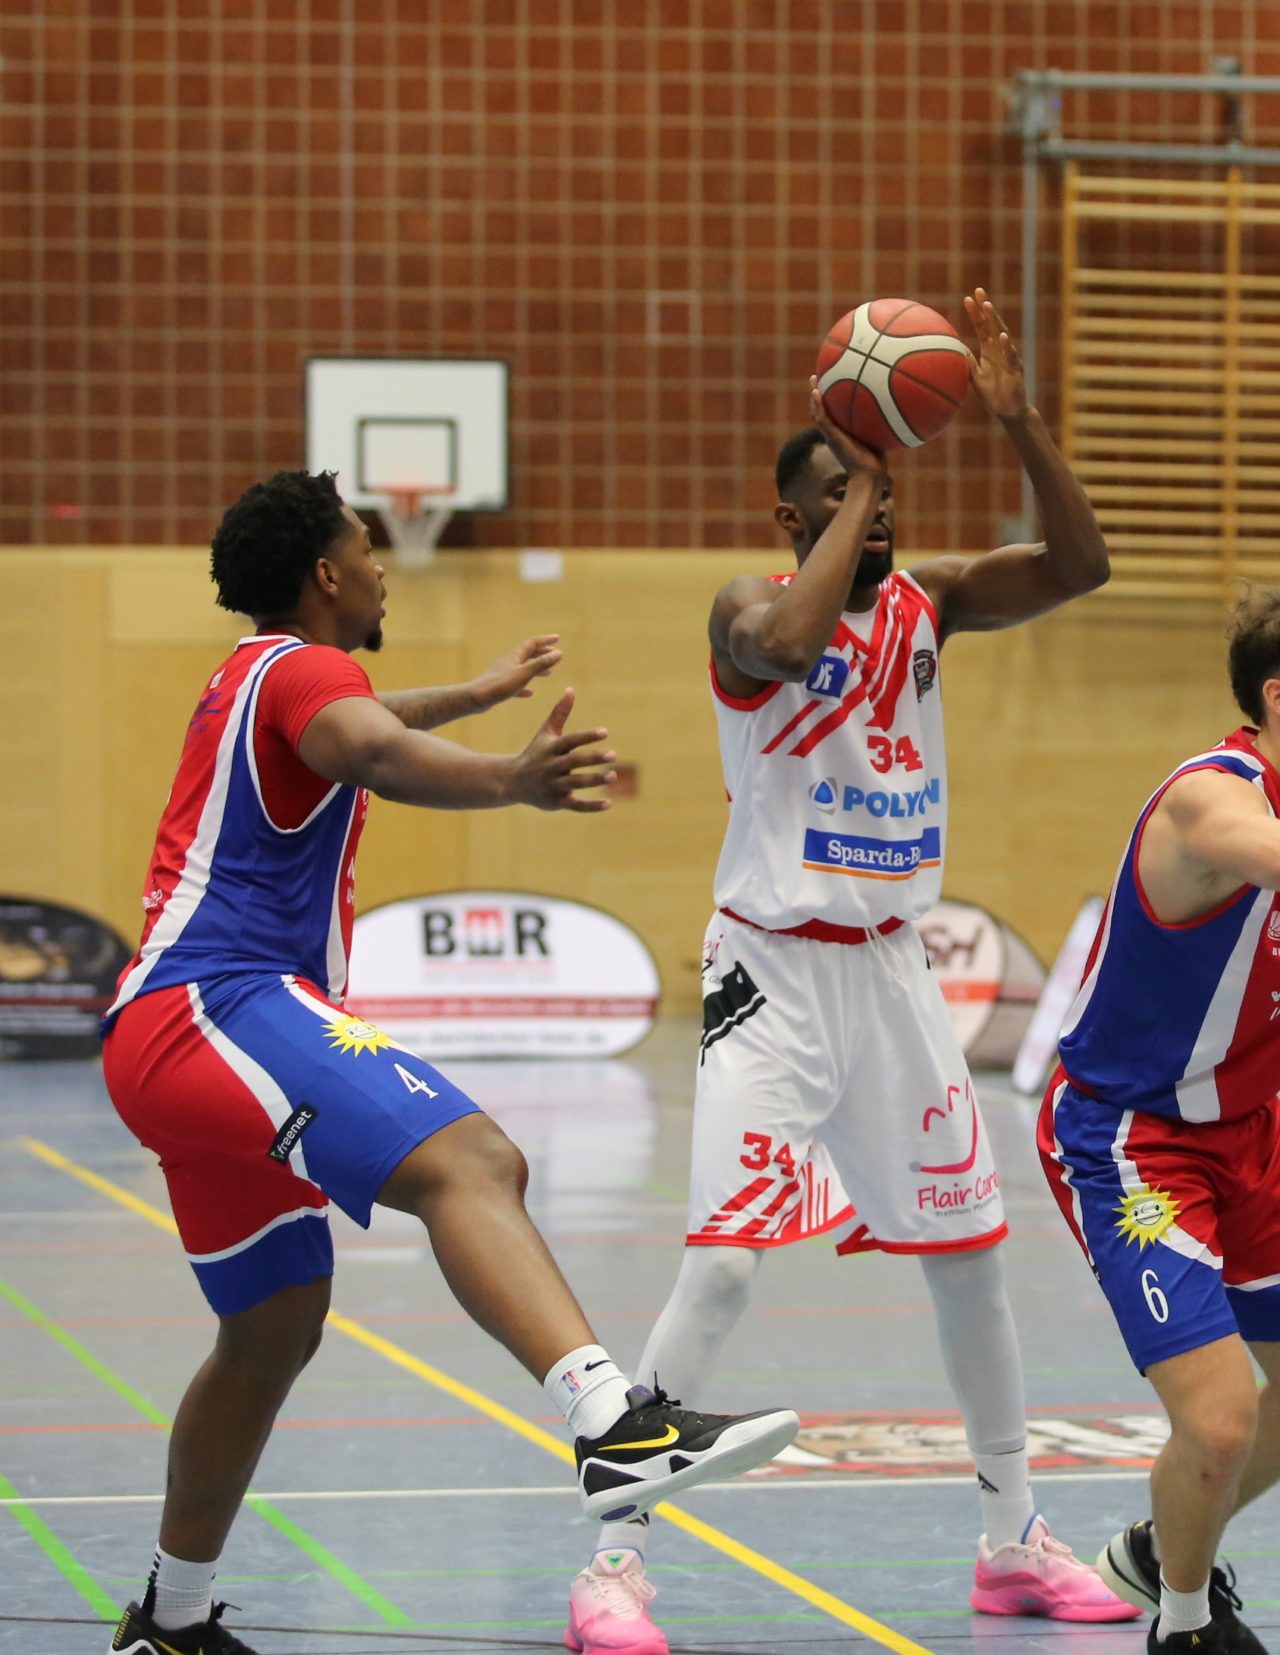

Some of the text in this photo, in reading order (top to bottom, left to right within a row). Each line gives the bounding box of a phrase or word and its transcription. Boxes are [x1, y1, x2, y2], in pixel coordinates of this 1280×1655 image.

[867, 735, 923, 774] 34
[394, 1063, 439, 1099] 4
[275, 1109, 313, 1156] freenet
[740, 1131, 795, 1178] 34
[917, 1182, 972, 1210] Flair
[1141, 1268, 1169, 1323] 6
